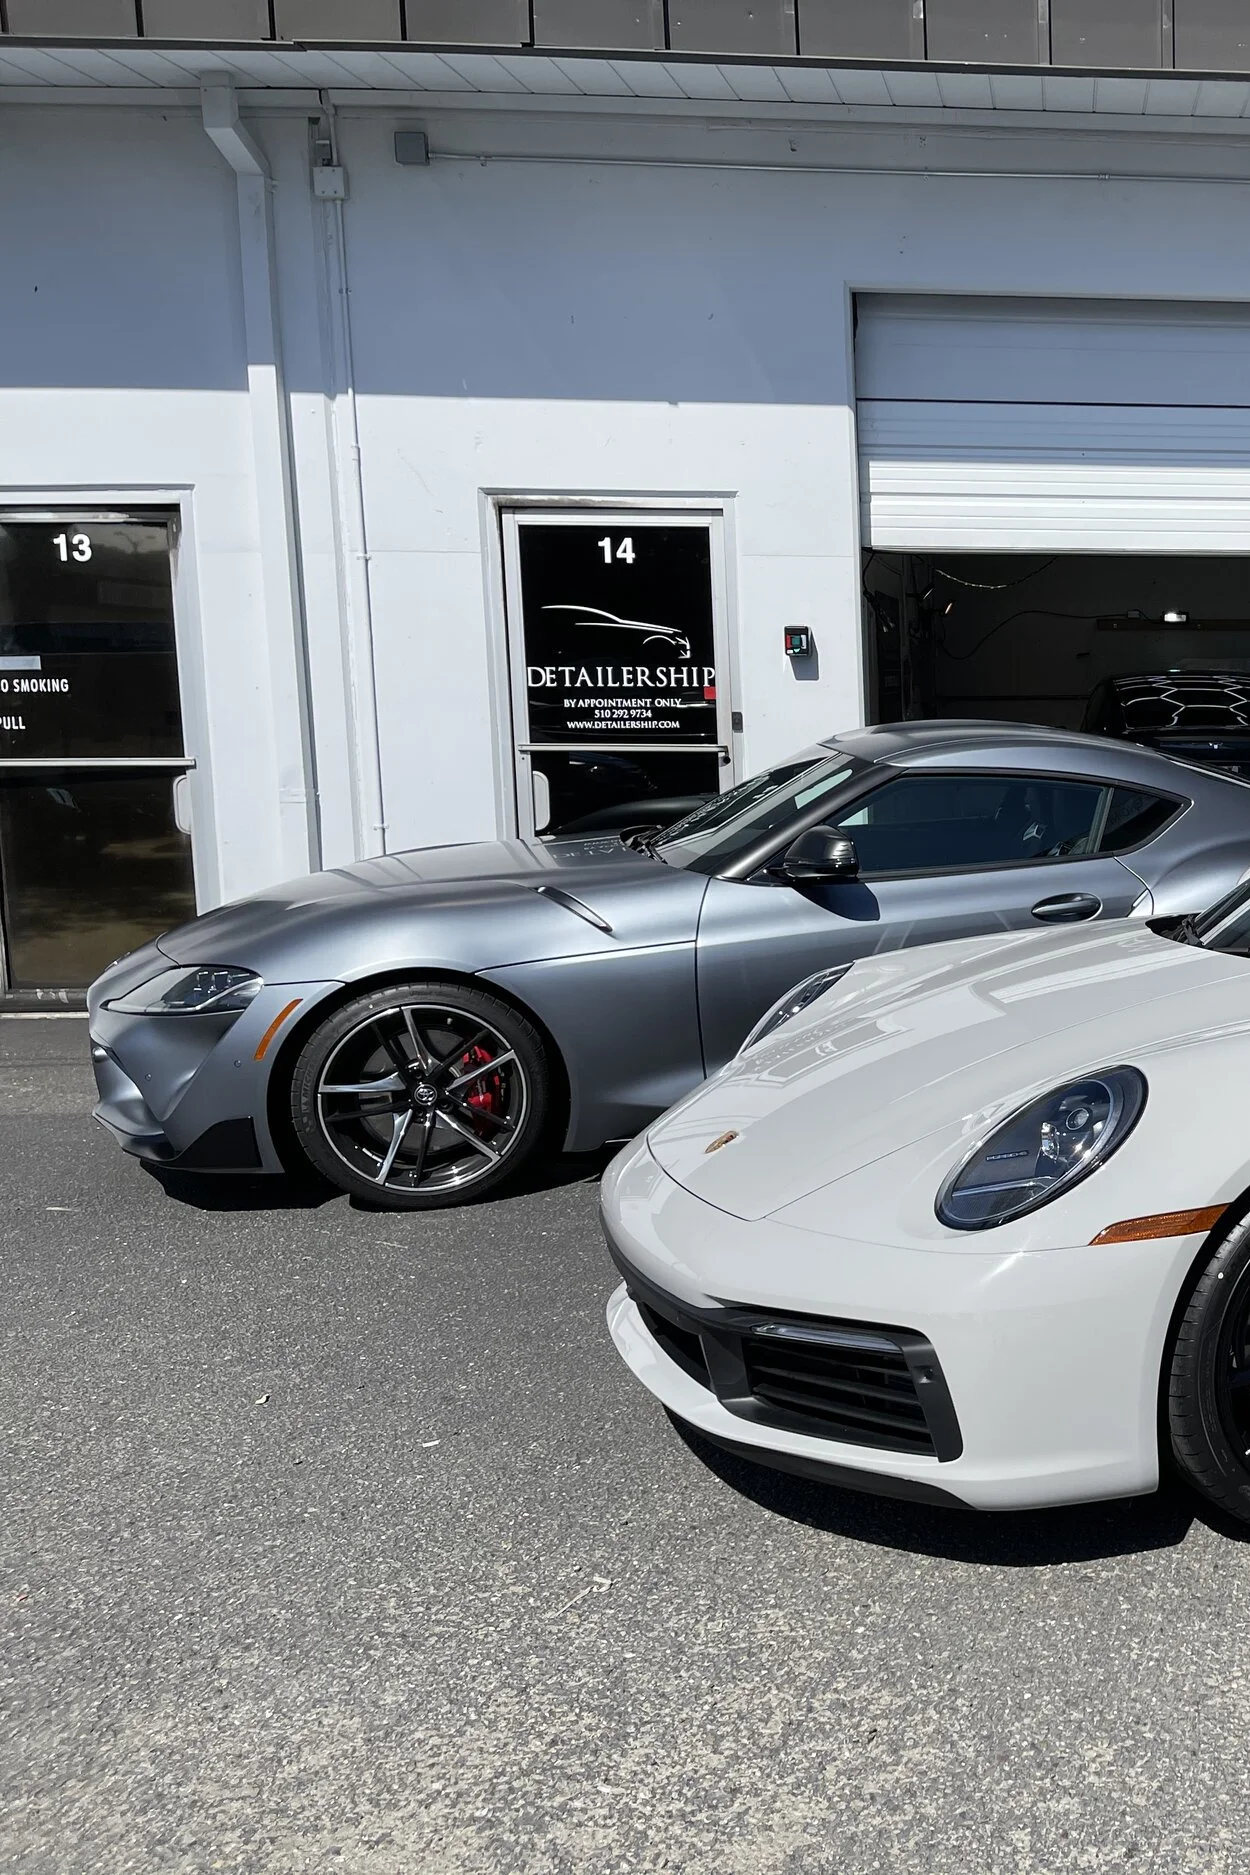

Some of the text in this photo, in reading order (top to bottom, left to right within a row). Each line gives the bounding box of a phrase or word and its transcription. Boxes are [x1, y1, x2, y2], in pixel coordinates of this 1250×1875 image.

[53, 533, 92, 562] 13
[598, 537, 635, 564] 14
[527, 666, 715, 687] DETAILERSHIP
[0, 679, 69, 692] O SMOKING
[564, 698, 682, 708] BY APPOINTMENT ONLY
[594, 710, 652, 718] 510 292 9734
[567, 721, 680, 729] WWW.DETAILERSHIP.COM
